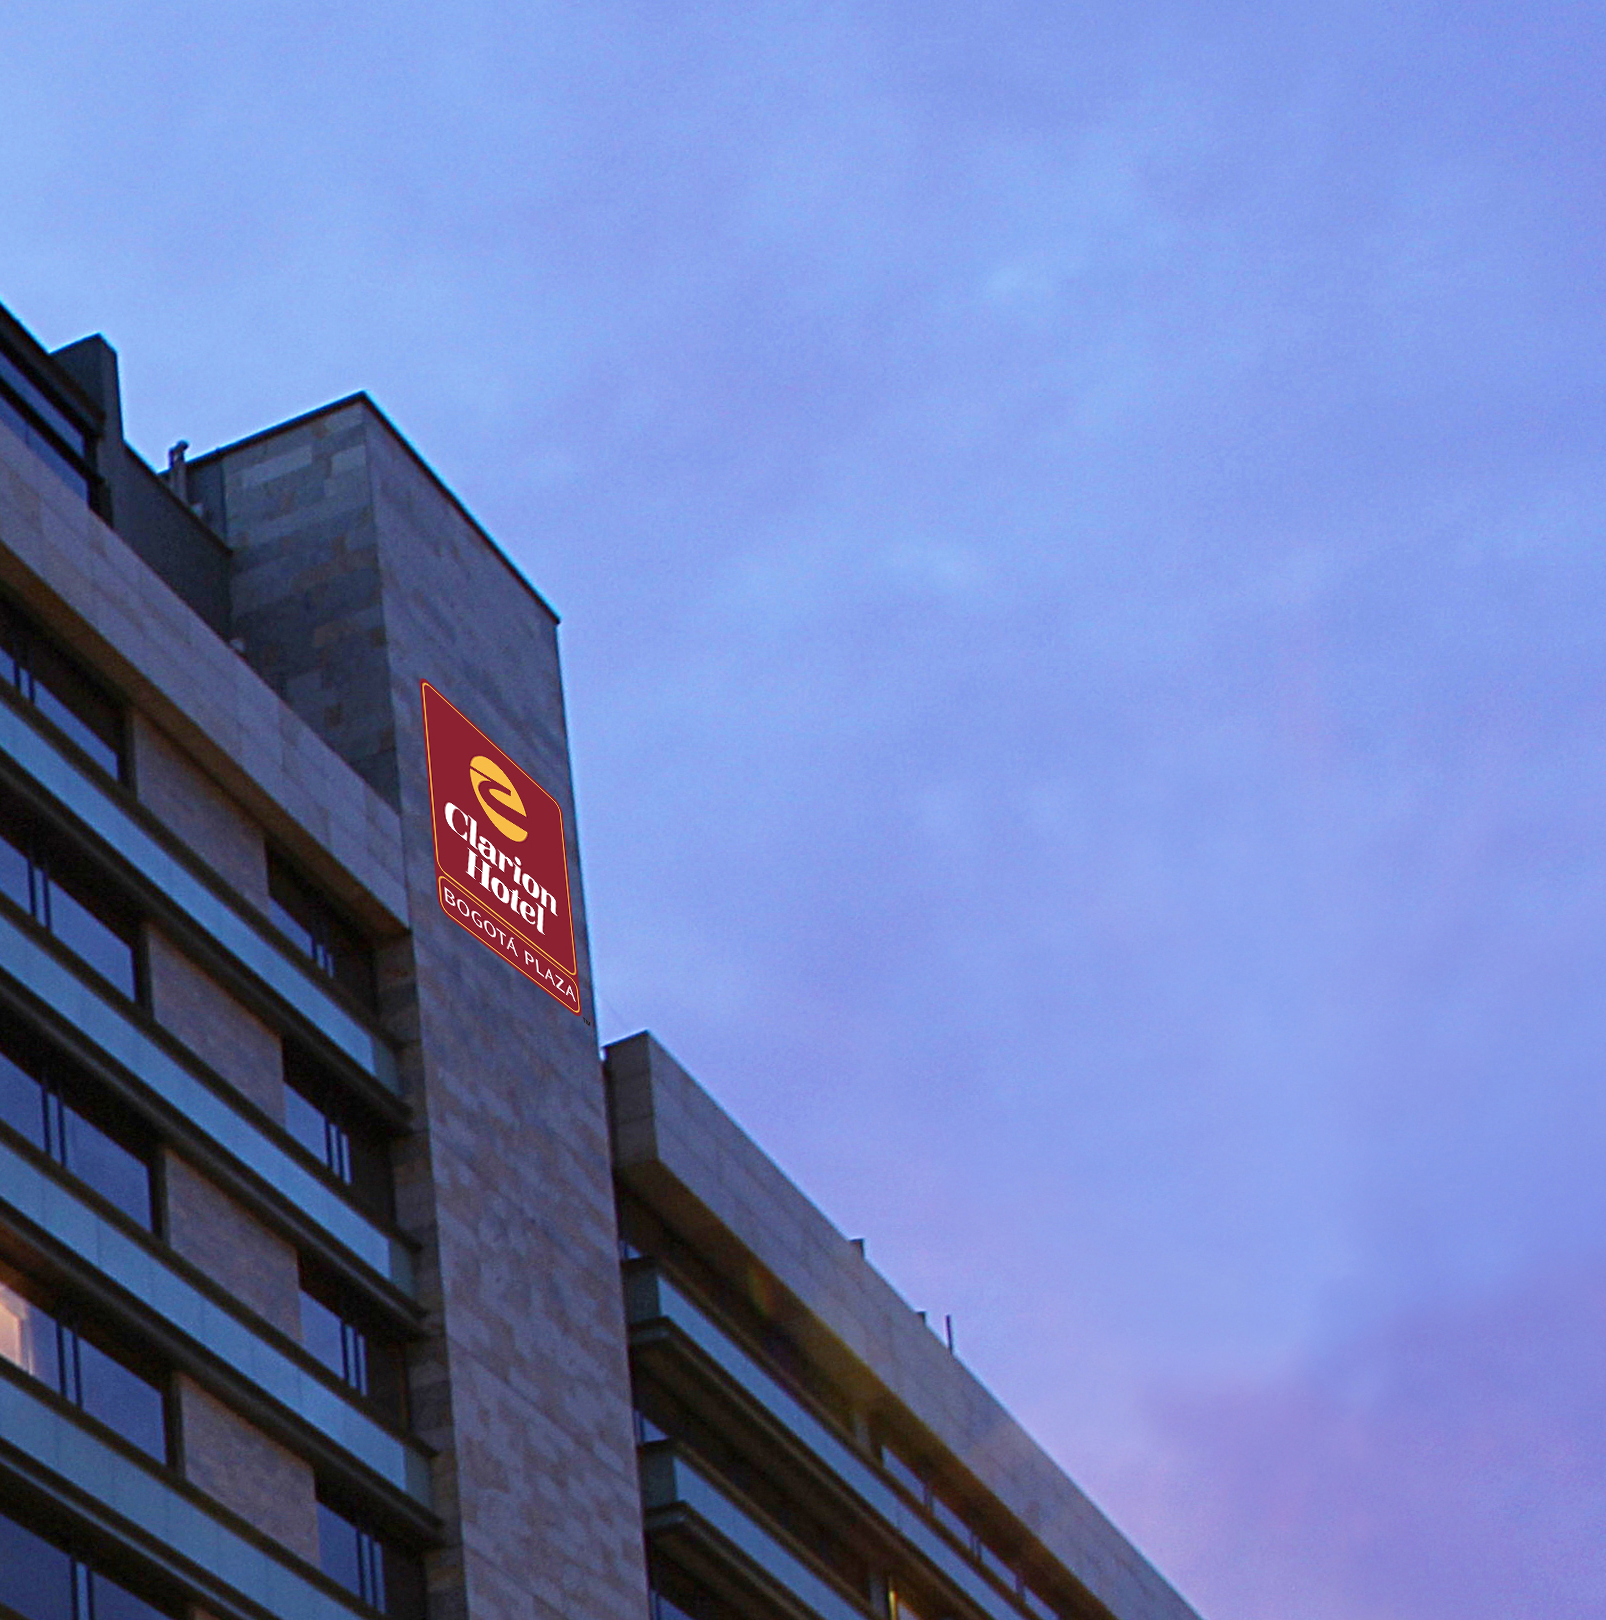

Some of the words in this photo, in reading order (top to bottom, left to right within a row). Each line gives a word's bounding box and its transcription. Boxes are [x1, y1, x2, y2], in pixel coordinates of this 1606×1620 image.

[444, 801, 558, 917] Clarion
[465, 847, 546, 935] Hotel
[443, 886, 518, 958] BOGOTÁ
[525, 950, 577, 1003] PLAZA
